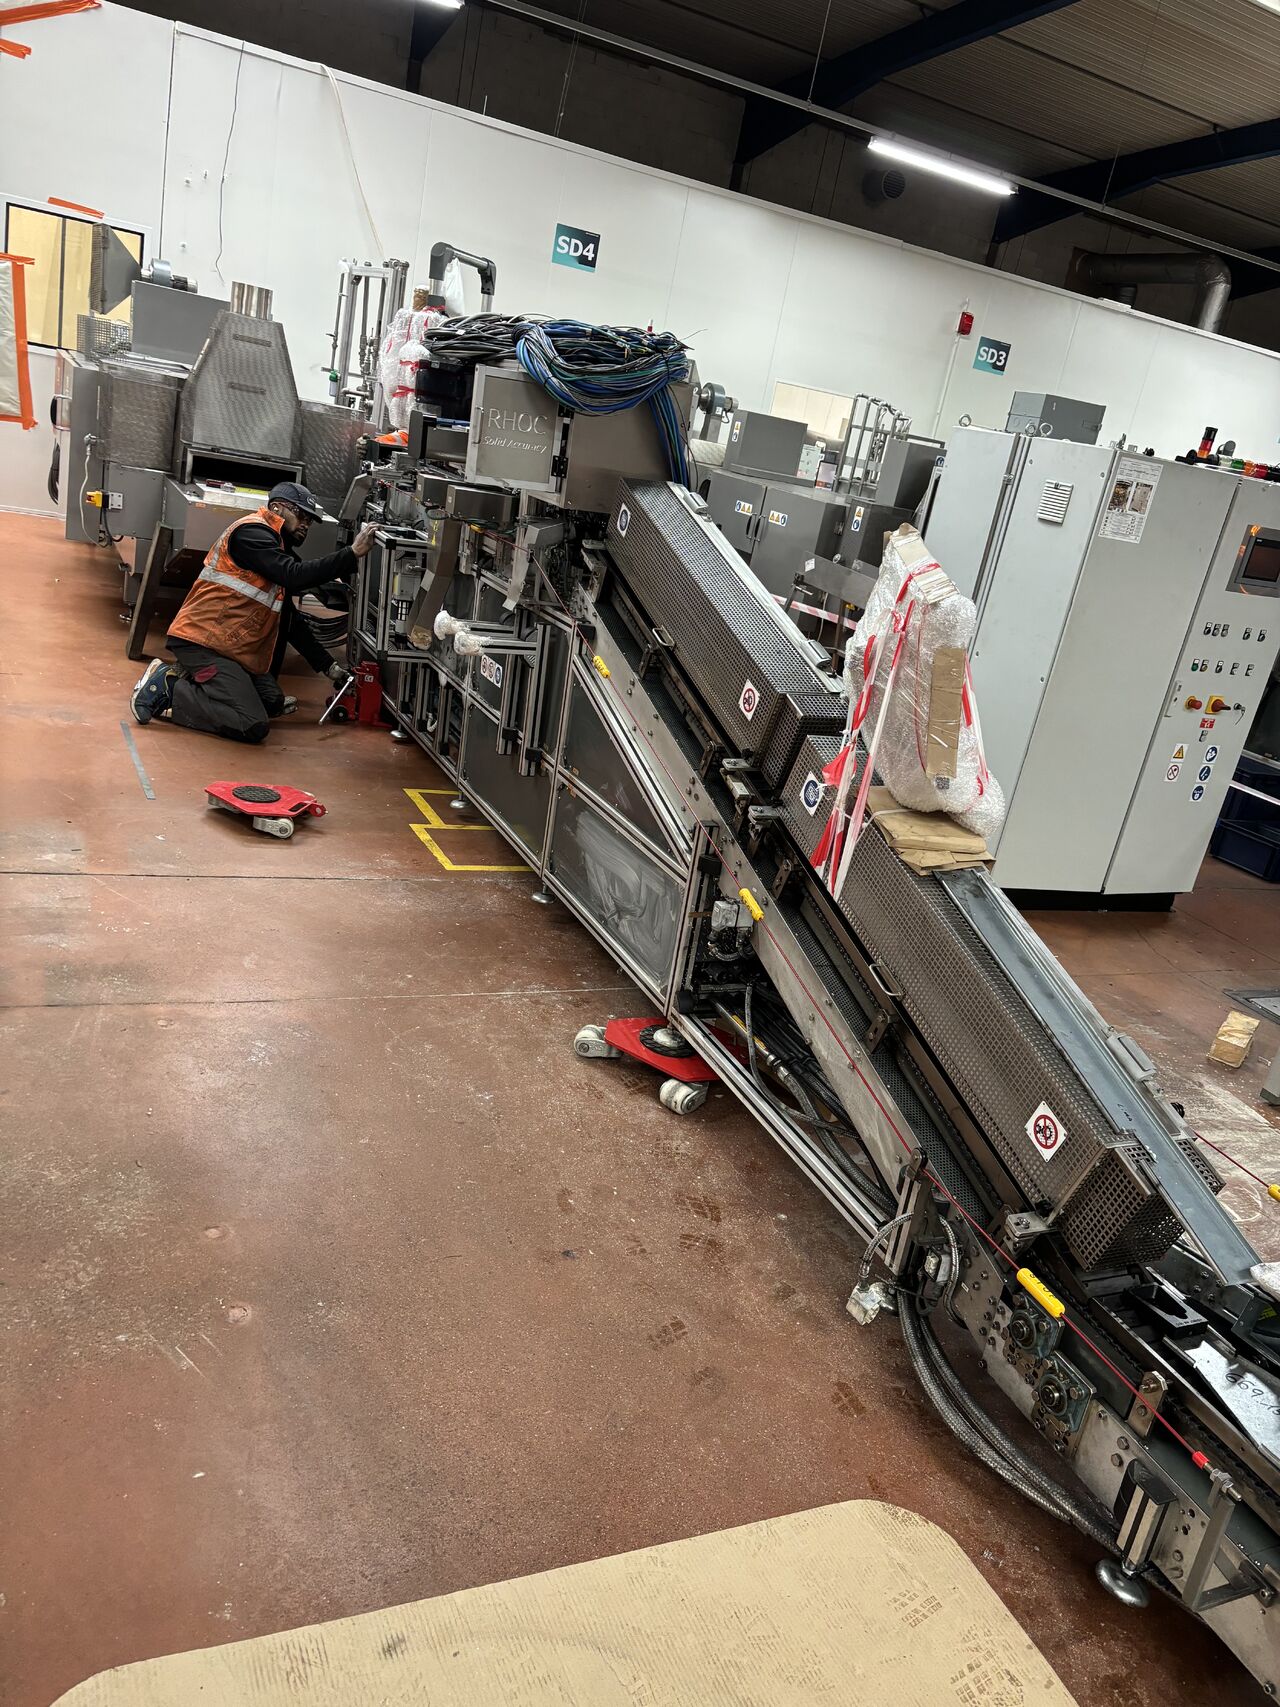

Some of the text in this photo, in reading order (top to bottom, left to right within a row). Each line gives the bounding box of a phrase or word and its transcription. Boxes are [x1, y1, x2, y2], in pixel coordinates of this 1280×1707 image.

[556, 235, 595, 261] SD4
[977, 346, 1007, 366] SD3
[487, 408, 548, 435] RHOC
